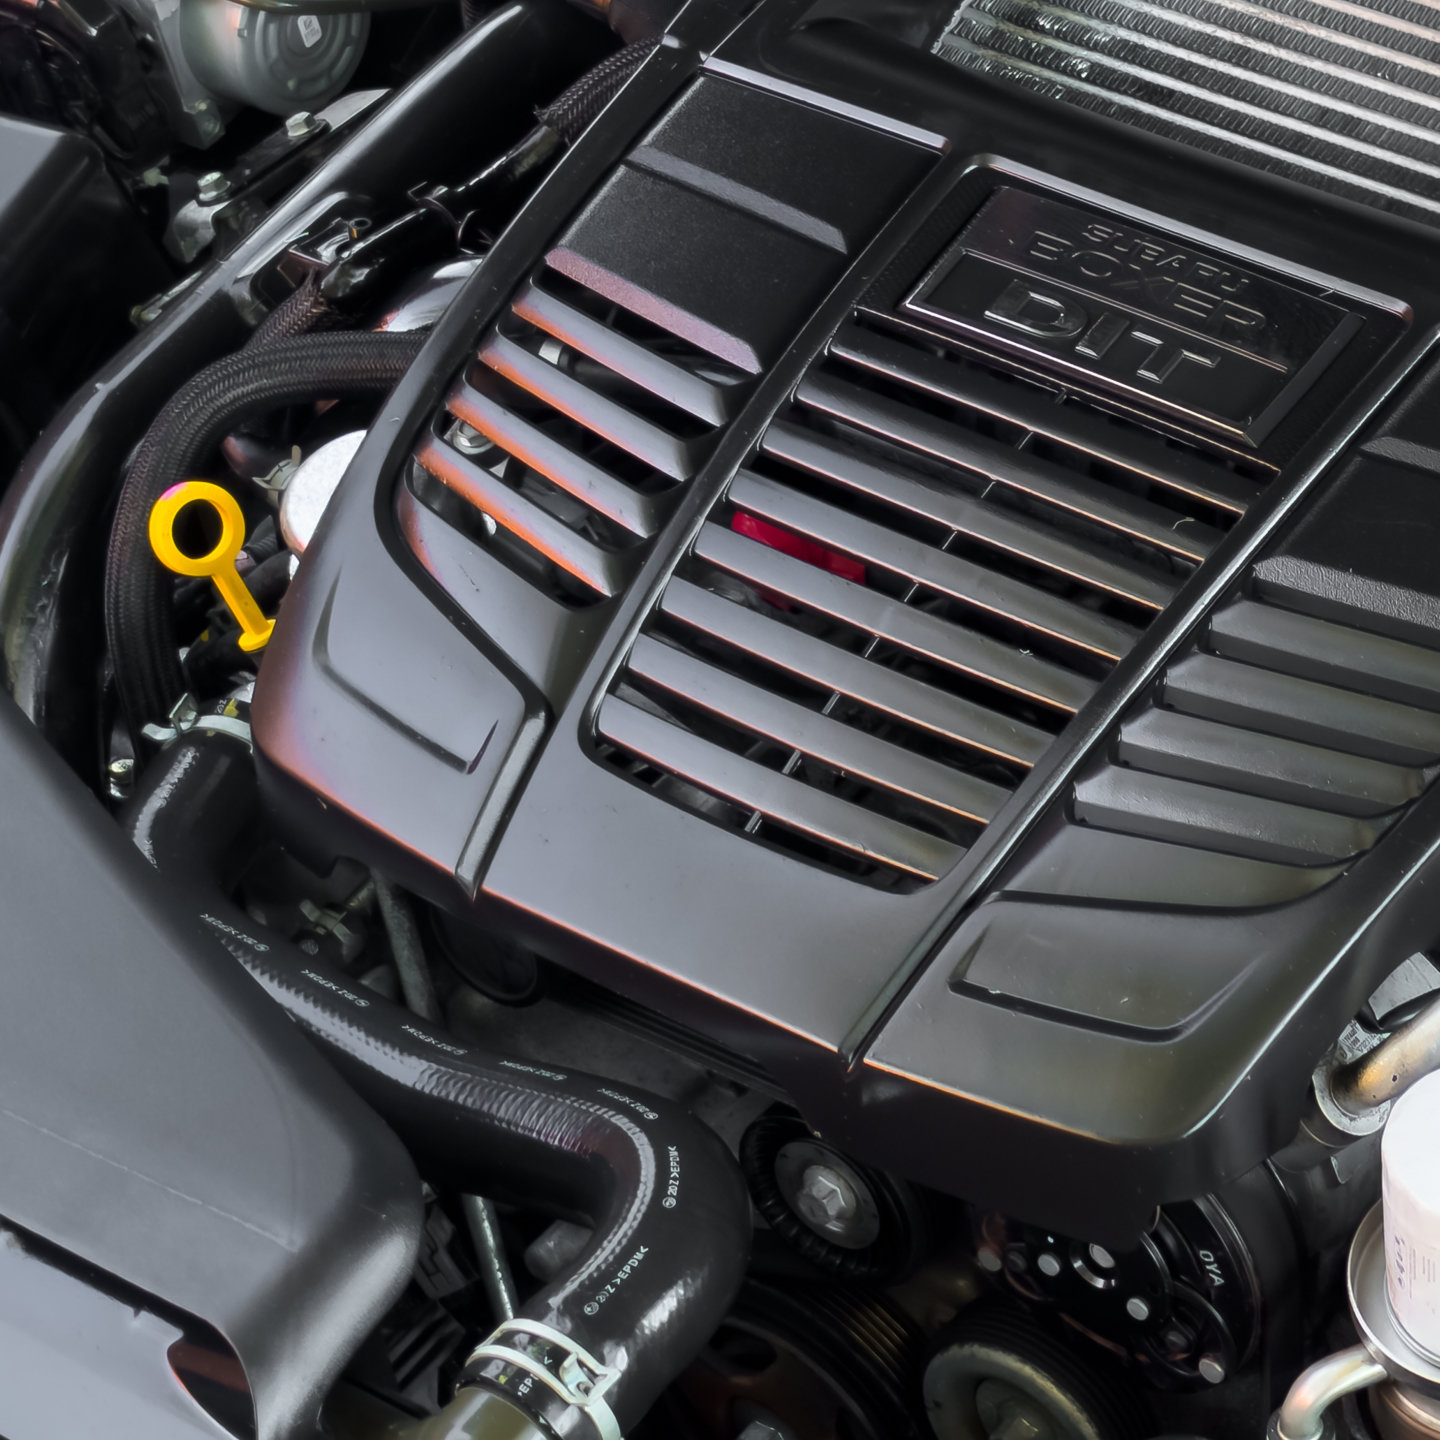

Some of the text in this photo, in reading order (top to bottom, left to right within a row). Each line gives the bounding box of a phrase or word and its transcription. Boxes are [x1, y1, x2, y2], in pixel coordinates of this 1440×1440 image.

[1026, 231, 1266, 334] BOXER
[1086, 222, 1251, 294] SUBARU
[983, 279, 1222, 384] DIT
